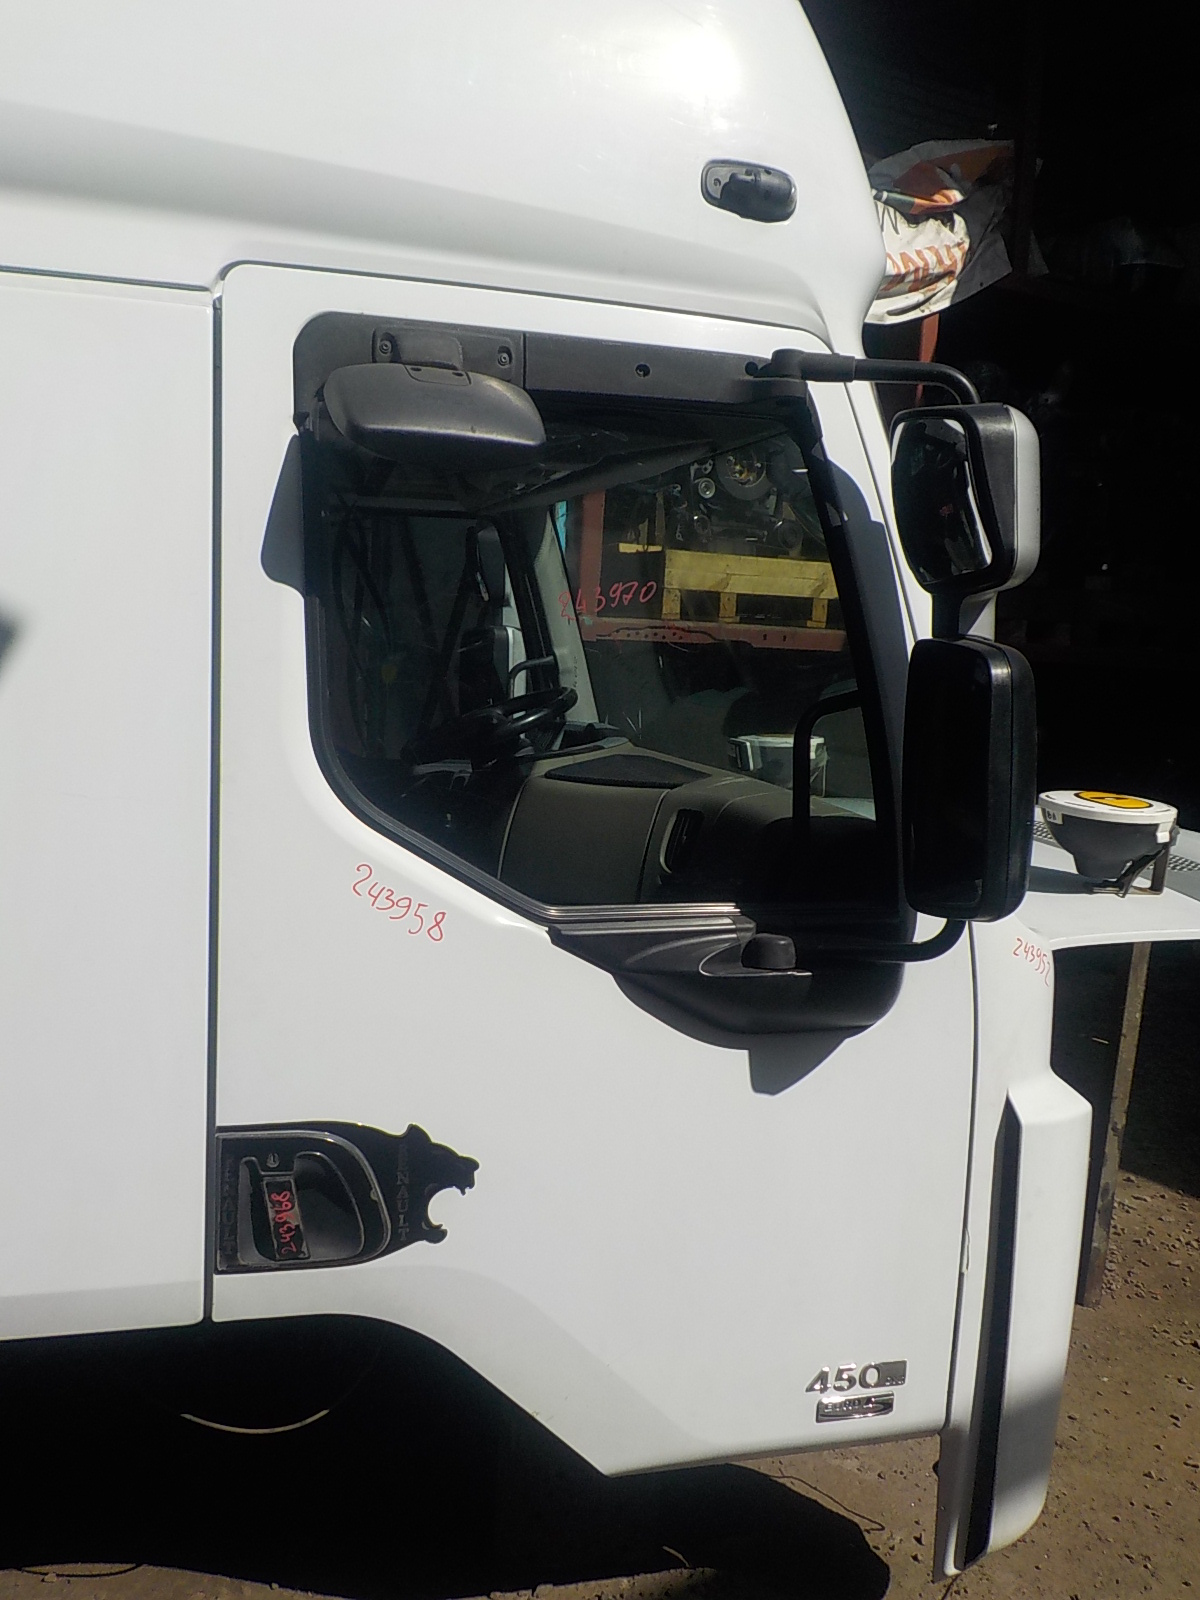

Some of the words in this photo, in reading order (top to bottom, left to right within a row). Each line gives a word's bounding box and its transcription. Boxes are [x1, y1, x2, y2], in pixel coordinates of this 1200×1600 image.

[352, 863, 447, 942] 243958
[269, 1190, 298, 1255] 243968
[805, 1362, 880, 1394] 450
